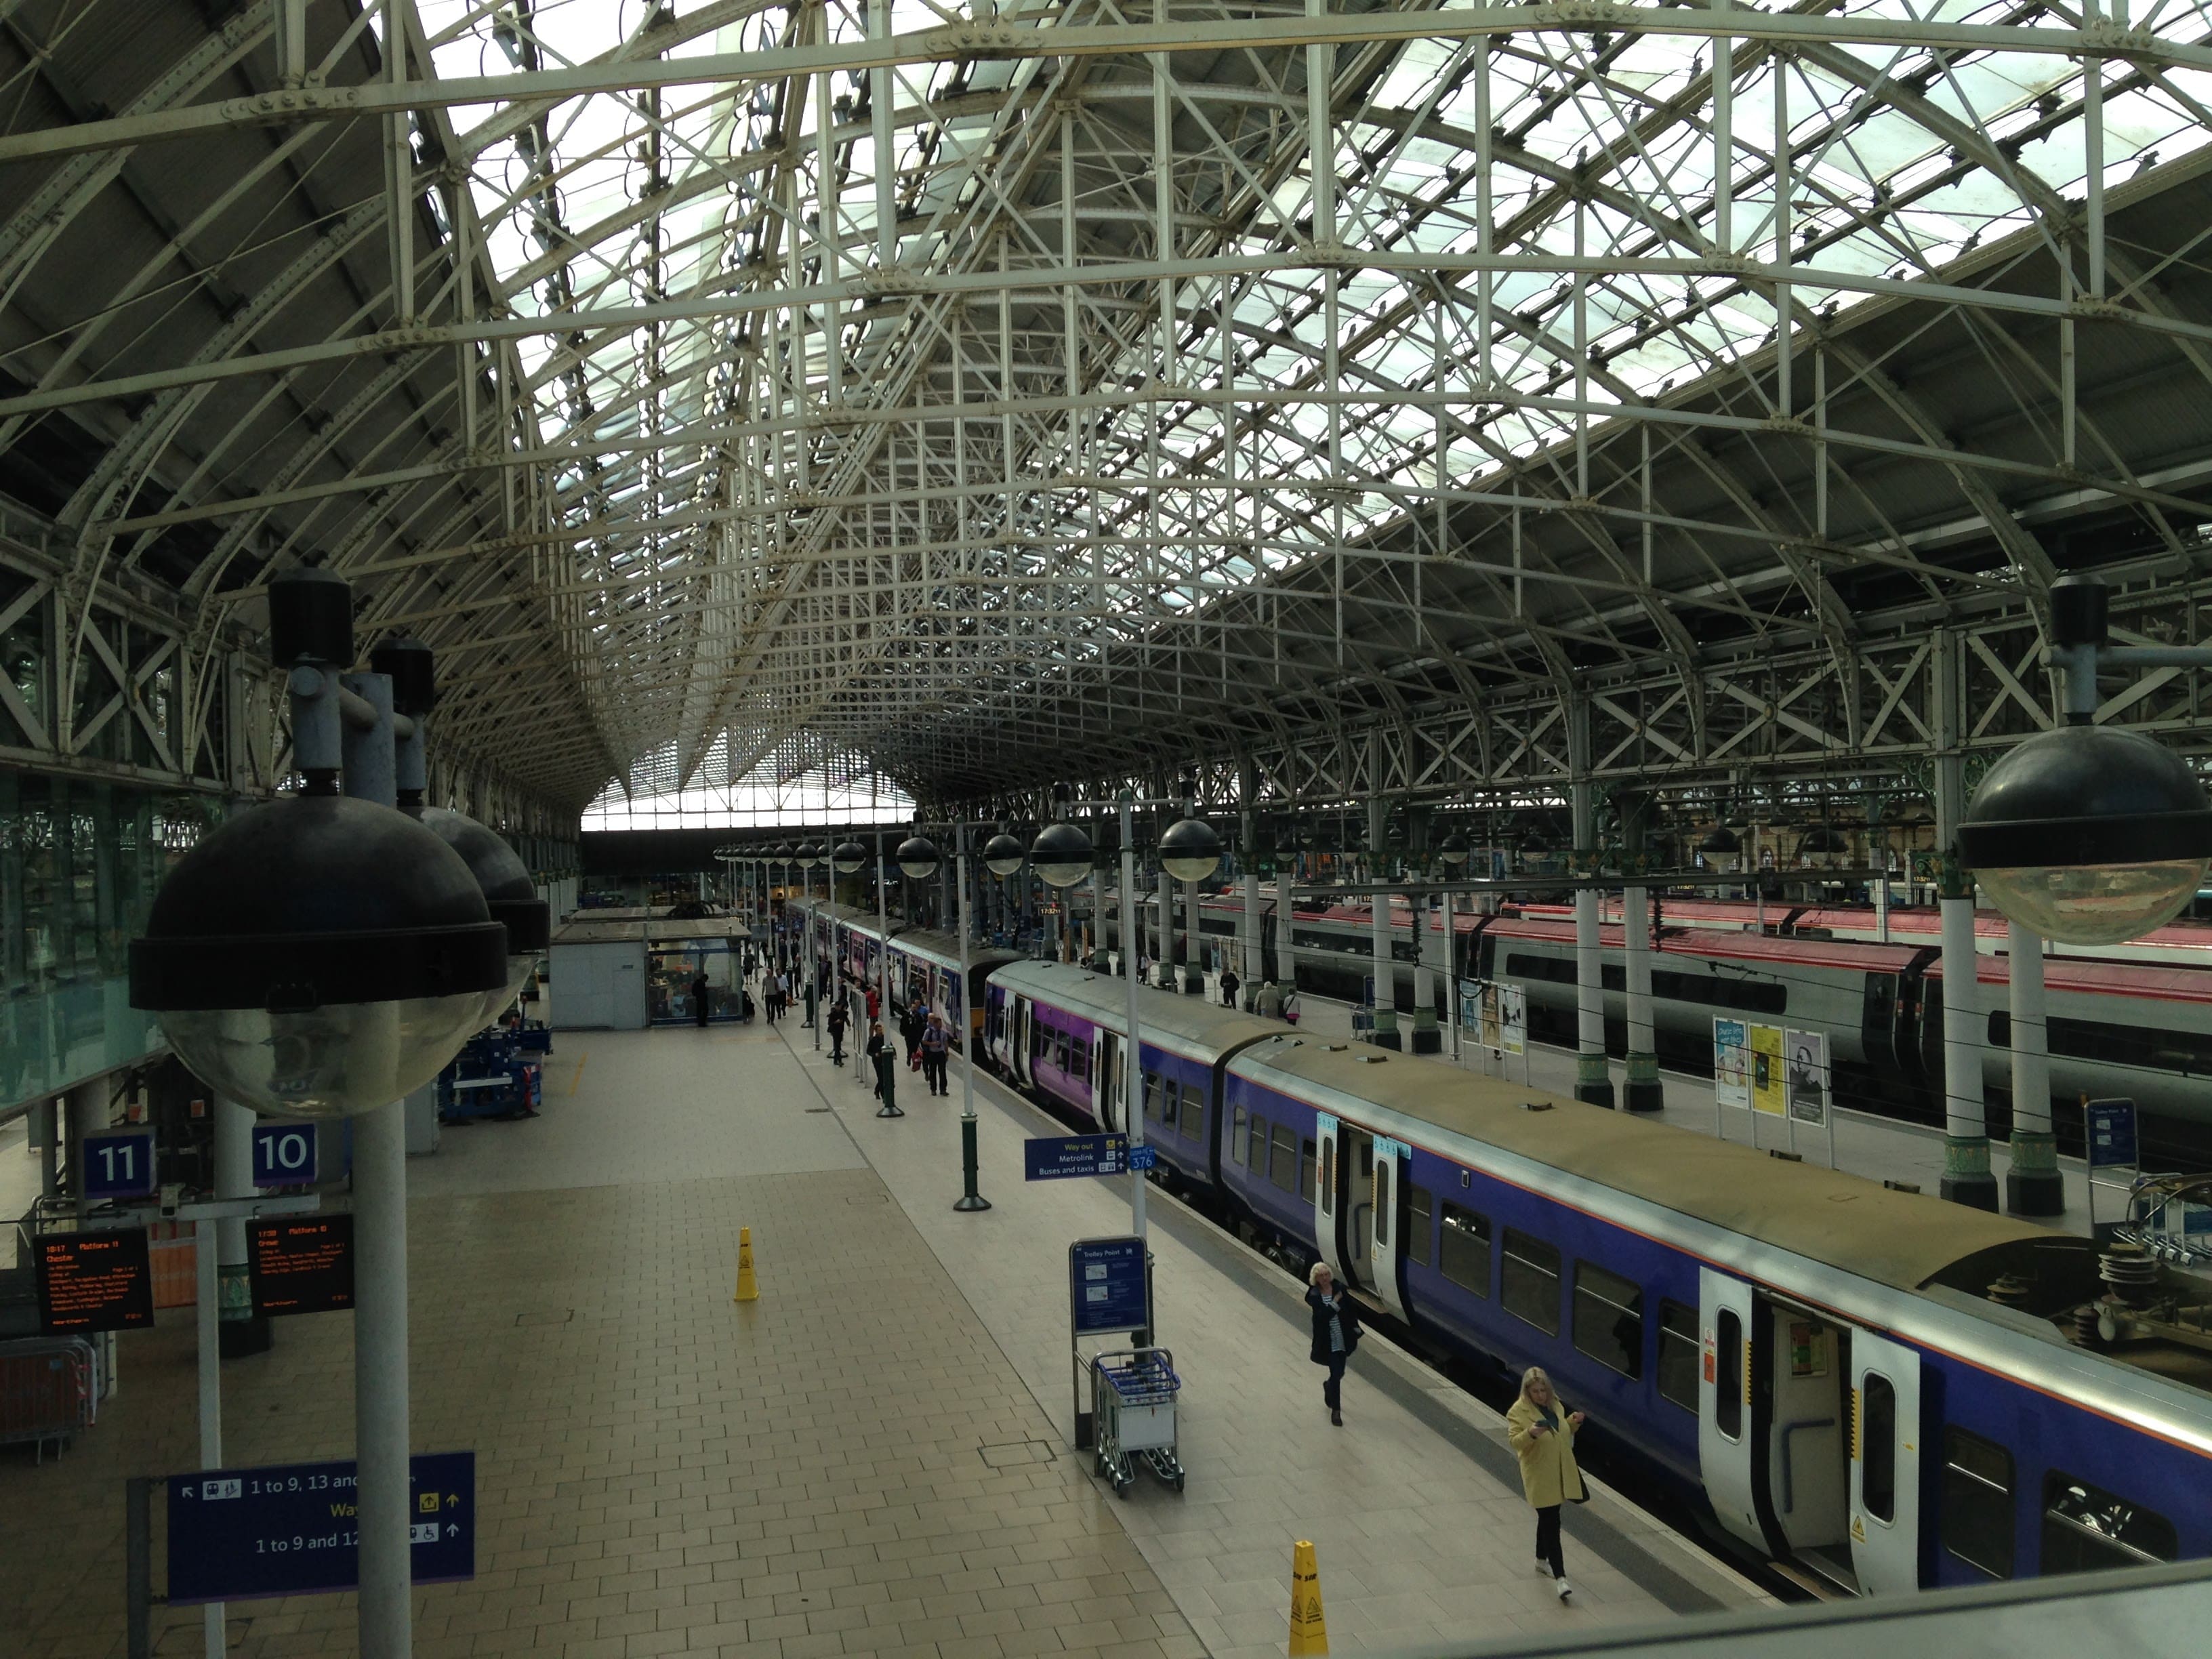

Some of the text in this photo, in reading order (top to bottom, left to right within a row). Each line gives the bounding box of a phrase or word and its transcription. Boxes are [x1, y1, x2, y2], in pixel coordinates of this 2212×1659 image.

[258, 1134, 307, 1170] 10
[1059, 1153, 1094, 1163] Metrolink
[98, 1145, 134, 1181] 11
[1039, 1165, 1094, 1176] Buses and taxis
[1132, 1156, 1153, 1169] 376
[251, 1481, 261, 1494] 1
[266, 1481, 283, 1494] to
[288, 1478, 302, 1492] 9,
[308, 1475, 329, 1490] 13
[256, 1540, 266, 1553] 1
[271, 1538, 288, 1552] to
[293, 1536, 304, 1550] 9
[308, 1533, 337, 1549] and
